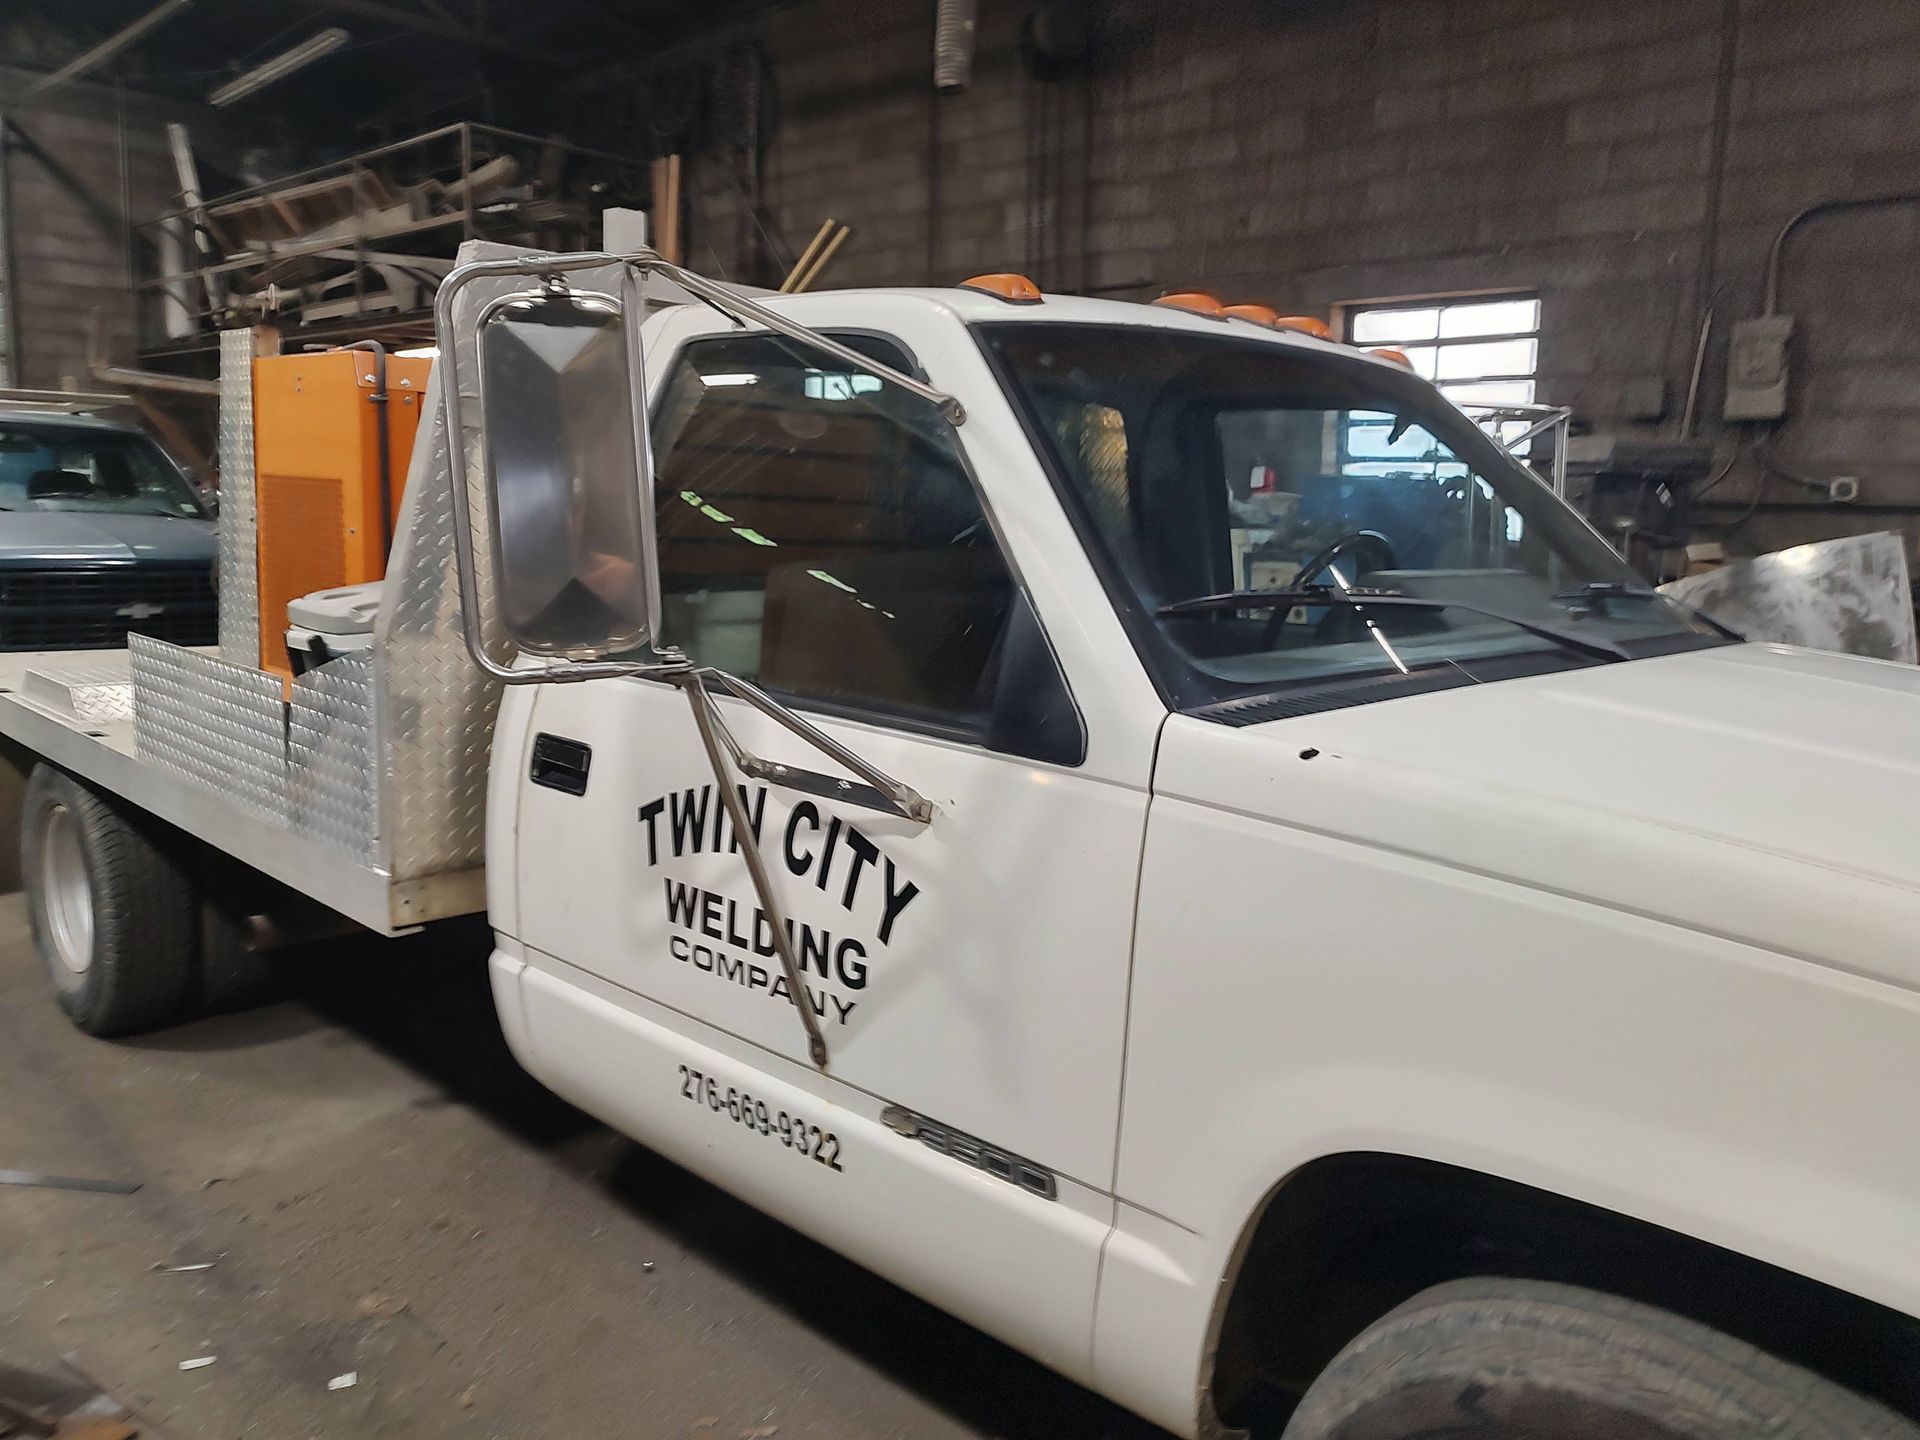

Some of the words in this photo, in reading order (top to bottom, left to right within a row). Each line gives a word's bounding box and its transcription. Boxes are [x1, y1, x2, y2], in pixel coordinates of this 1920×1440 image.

[638, 784, 767, 866] TWIN
[783, 801, 920, 946] CITY
[668, 935, 856, 1025] COMPANY
[679, 1064, 844, 1173] 276-669-9322
